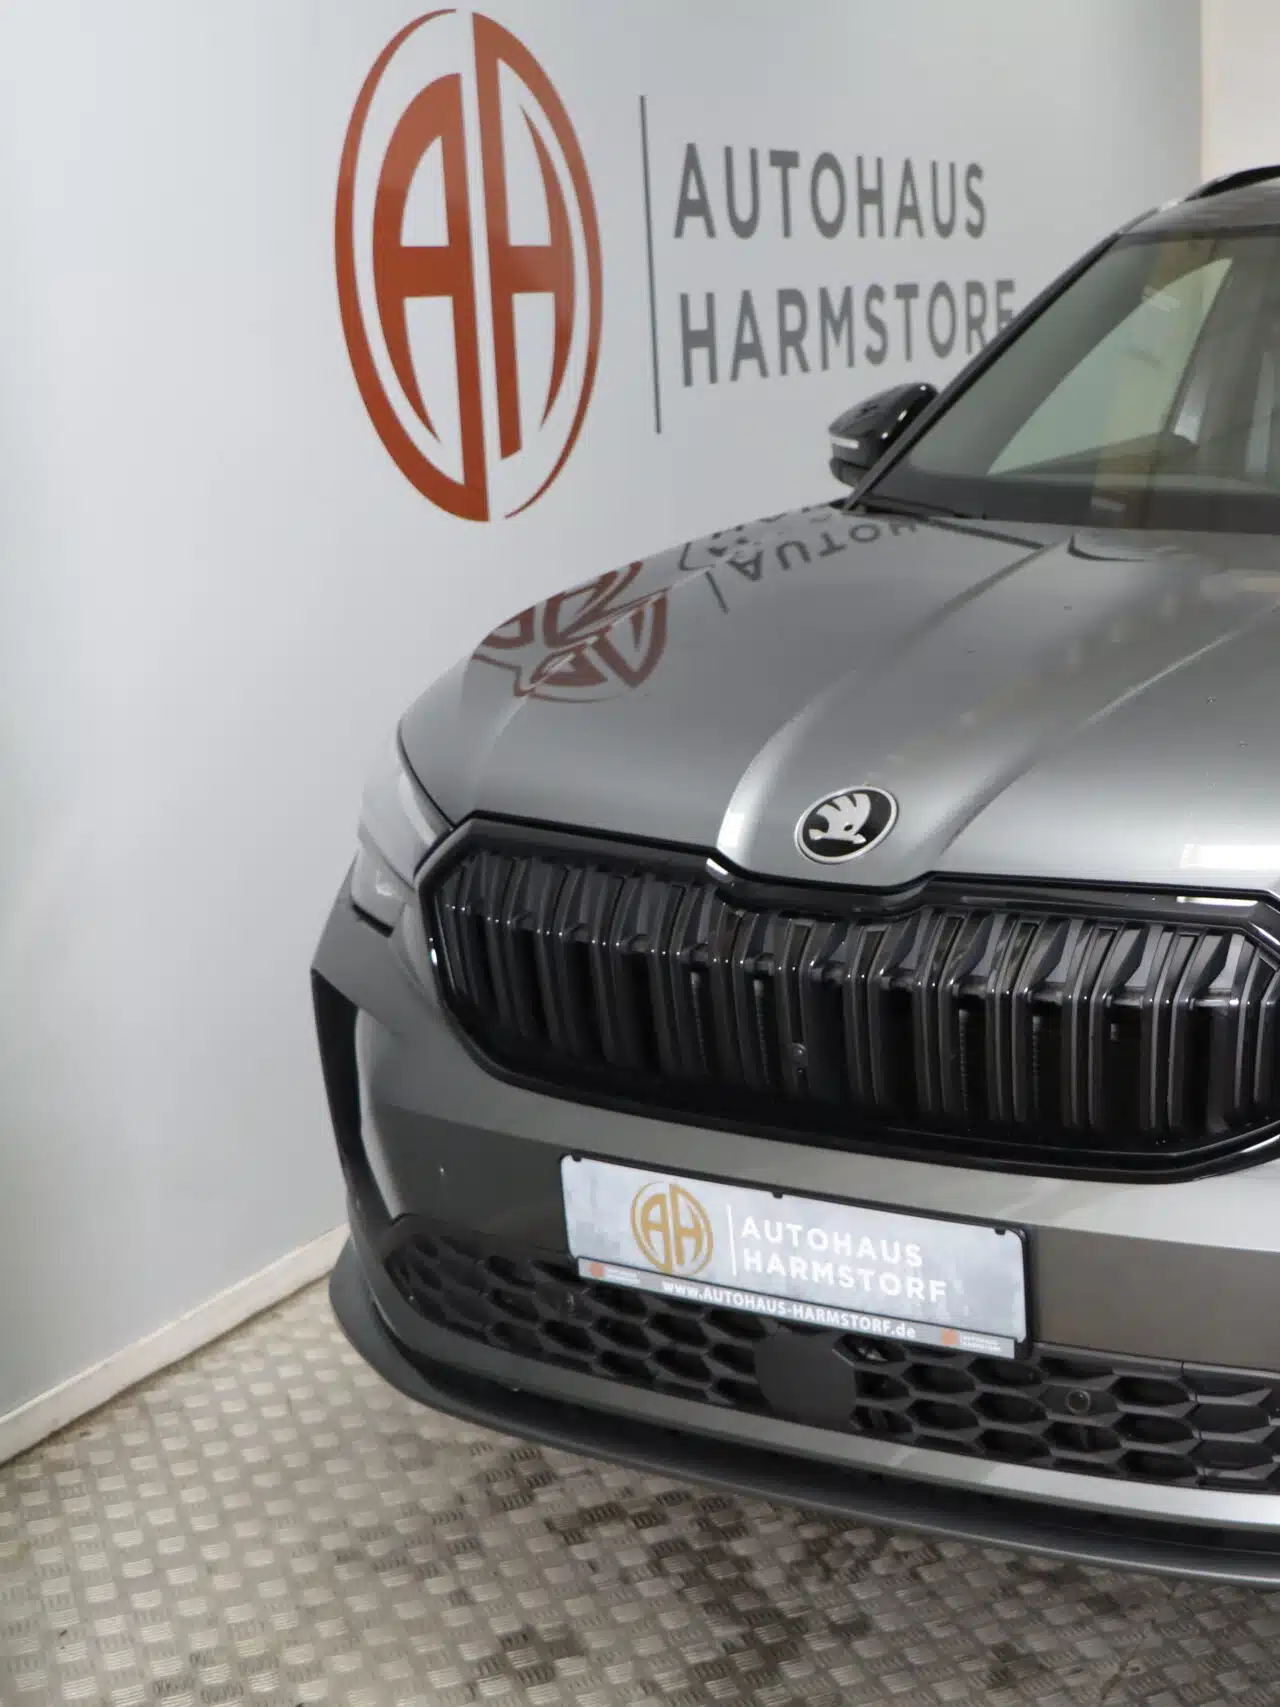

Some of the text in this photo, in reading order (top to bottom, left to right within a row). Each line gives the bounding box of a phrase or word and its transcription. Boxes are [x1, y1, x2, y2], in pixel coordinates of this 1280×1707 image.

[673, 143, 987, 239] AUTOHAUS
[680, 279, 1014, 387] HARMSTORF
[741, 1215, 924, 1267] AUTOHAUS
[742, 1248, 947, 1303] HARMSTORF
[662, 1281, 917, 1339] www.AUTOHAUS-HARMSTORF.de
